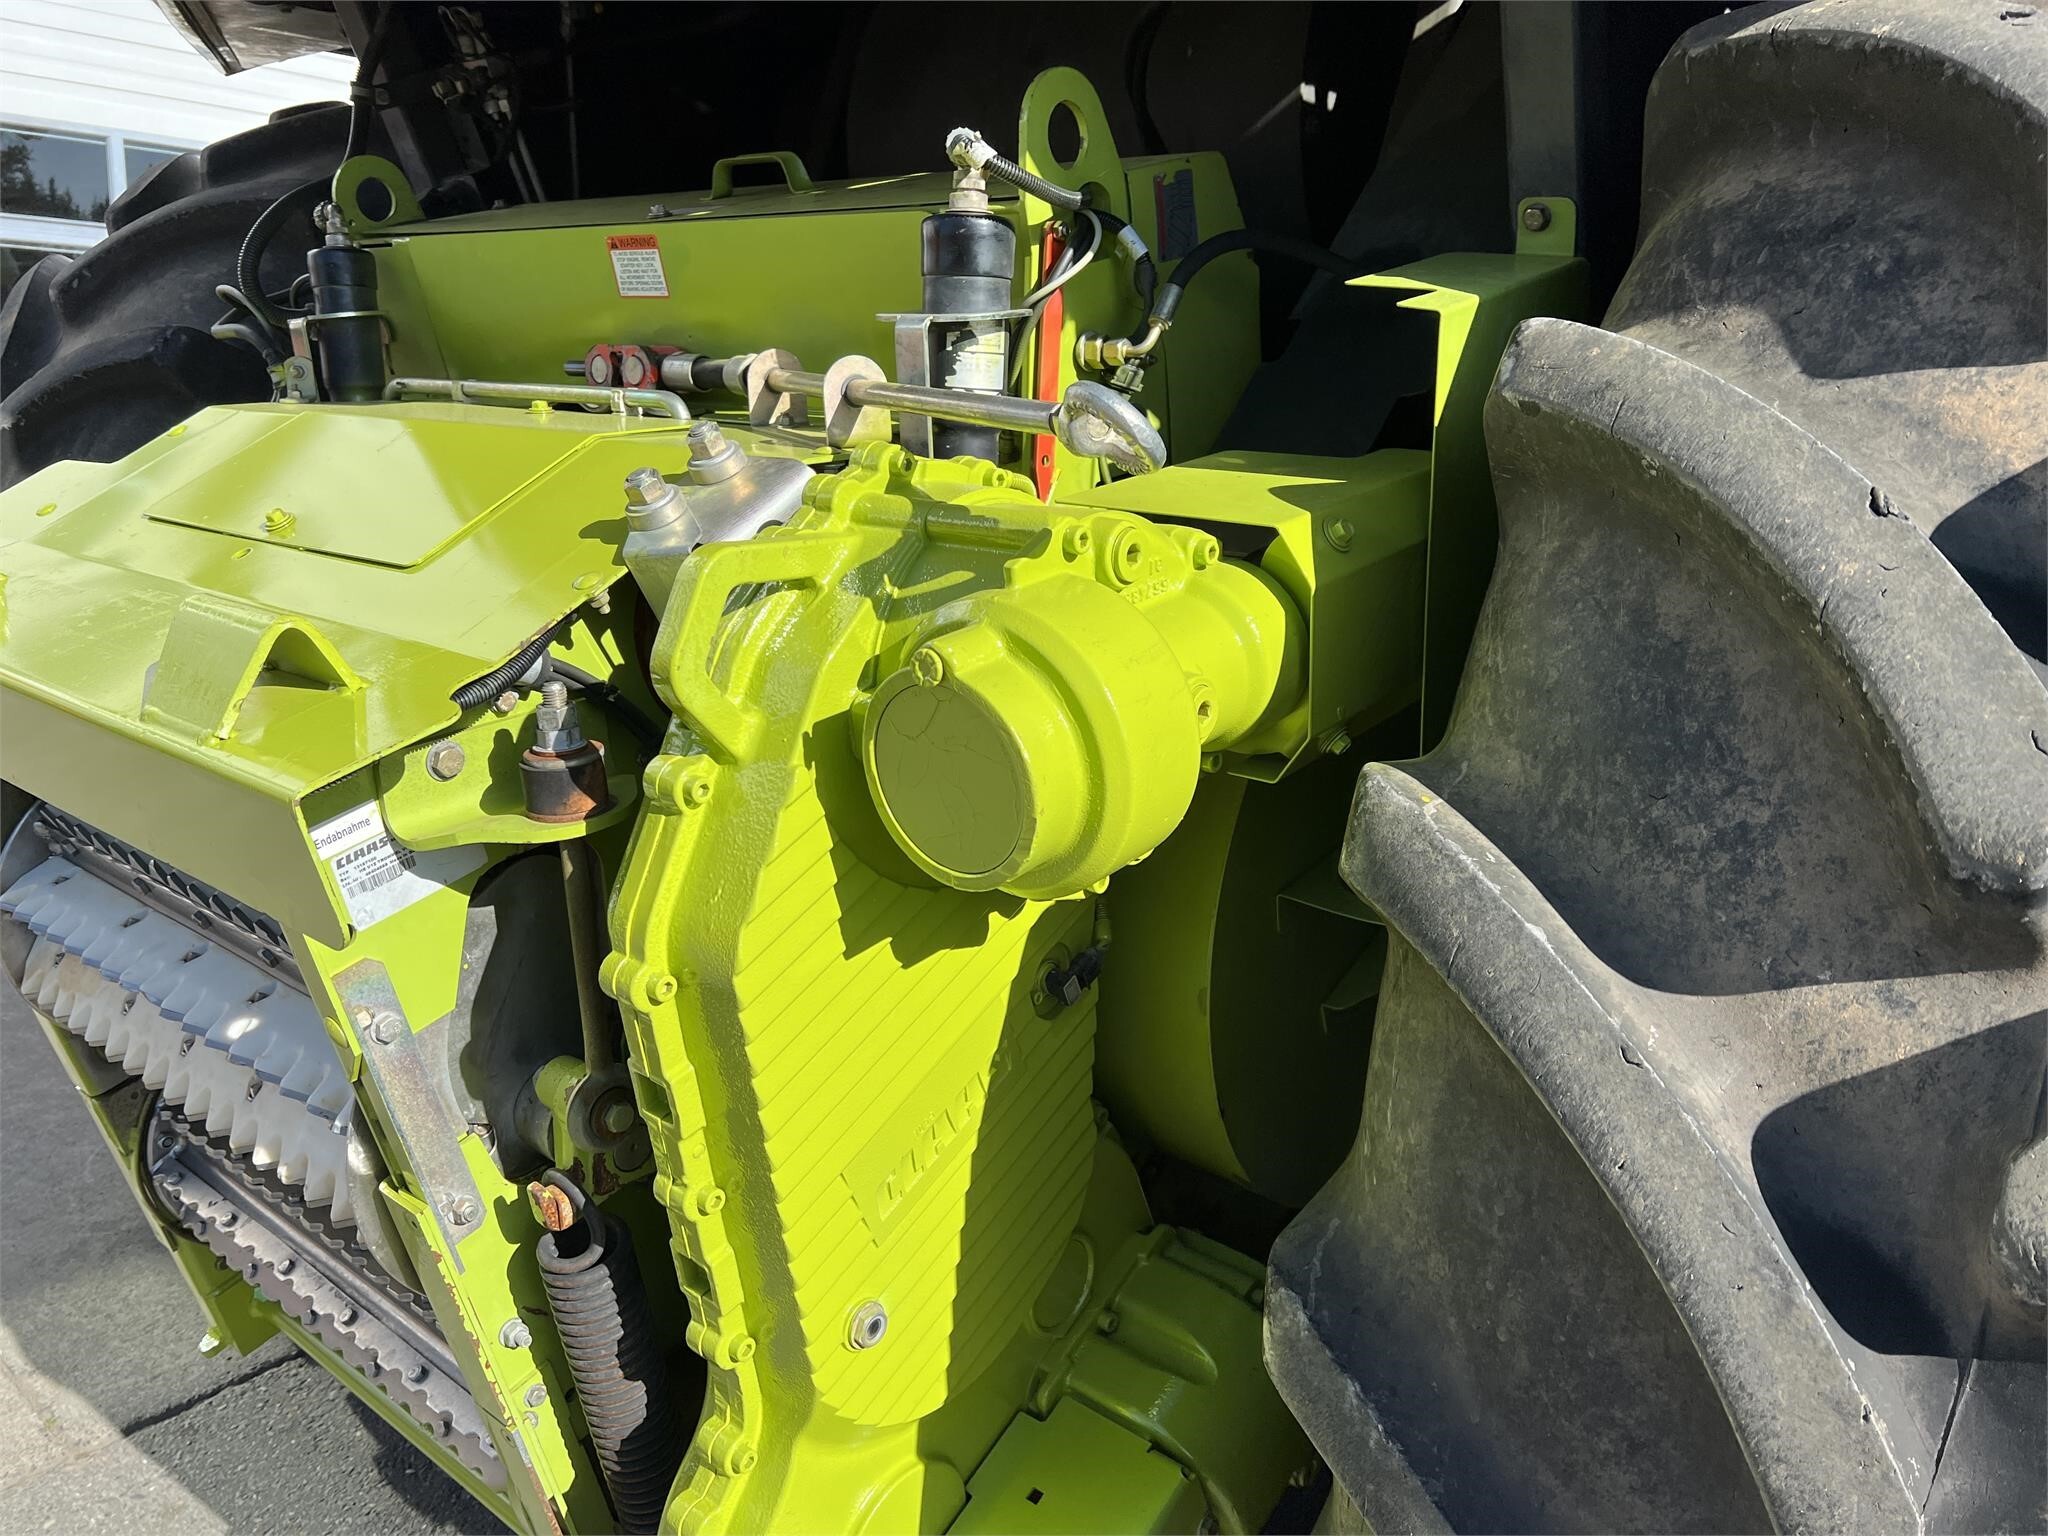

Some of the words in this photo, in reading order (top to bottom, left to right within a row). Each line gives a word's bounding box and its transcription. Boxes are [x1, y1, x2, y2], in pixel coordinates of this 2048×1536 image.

[619, 236, 657, 248] WARNING
[314, 816, 372, 850] Endabnahme
[336, 836, 391, 870] CLAAS
